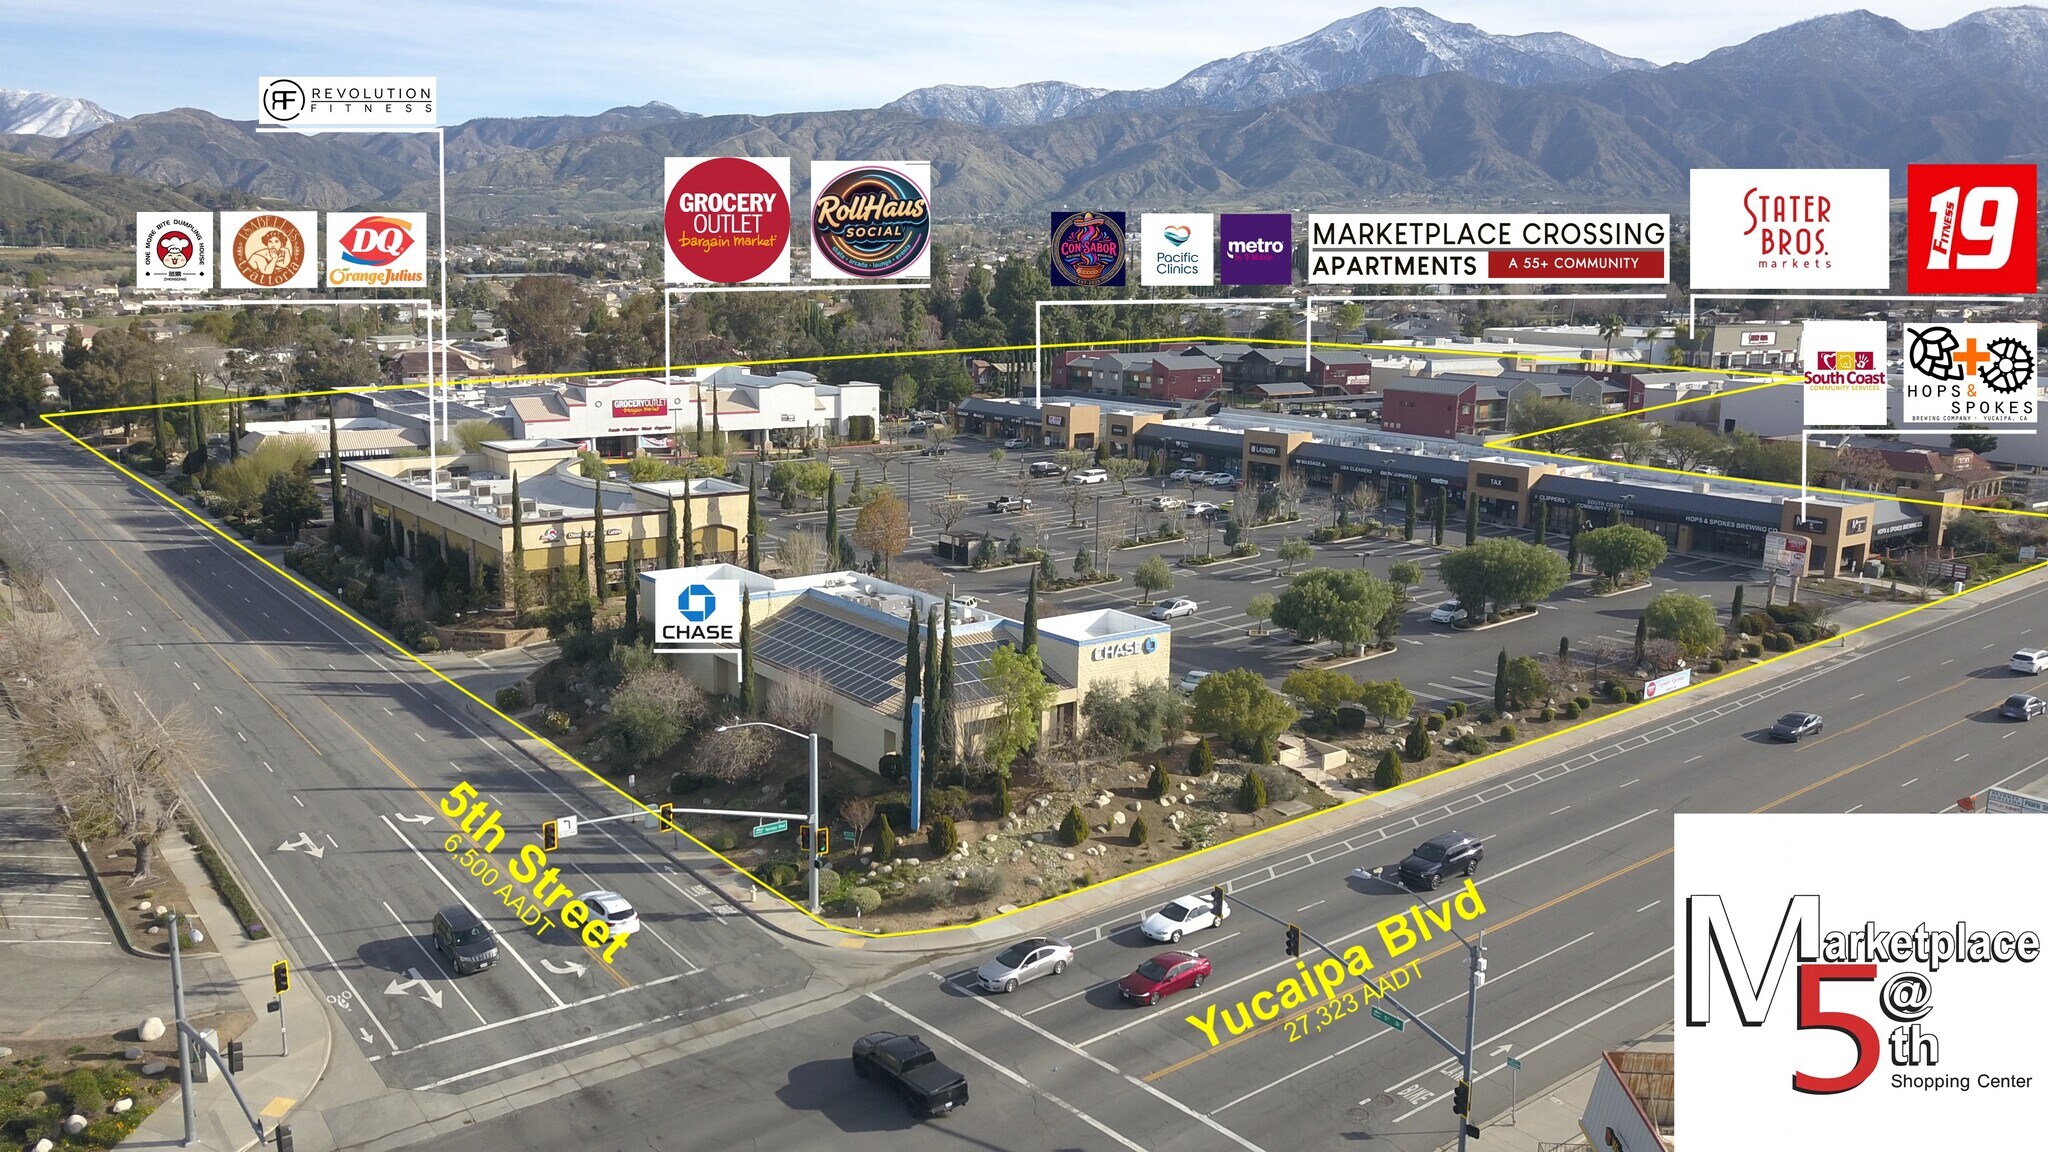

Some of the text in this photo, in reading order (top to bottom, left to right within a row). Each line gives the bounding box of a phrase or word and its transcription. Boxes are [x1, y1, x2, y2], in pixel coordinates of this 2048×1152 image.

[365, 448, 390, 456] FITNESS
[1256, 447, 1277, 455] LAUNDRY
[1350, 466, 1373, 474] CLEANERS
[1431, 477, 1448, 485] metro
[1490, 478, 1502, 486] TAX
[1539, 494, 1566, 504] CLIPPERS
[1587, 499, 1624, 509] SOUTH COAST
[1685, 515, 1703, 524] HOPS
[1709, 518, 1736, 529] SPOKES
[1736, 522, 1767, 533] BREWING
[1877, 527, 1887, 535] HOPS
[1890, 524, 1903, 533] SPOKES
[1903, 522, 1917, 530] BREWING
[1092, 642, 1141, 661] CHASE
[2025, 800, 2040, 809] PAWN
[1397, 1083, 1435, 1105] BIKE
